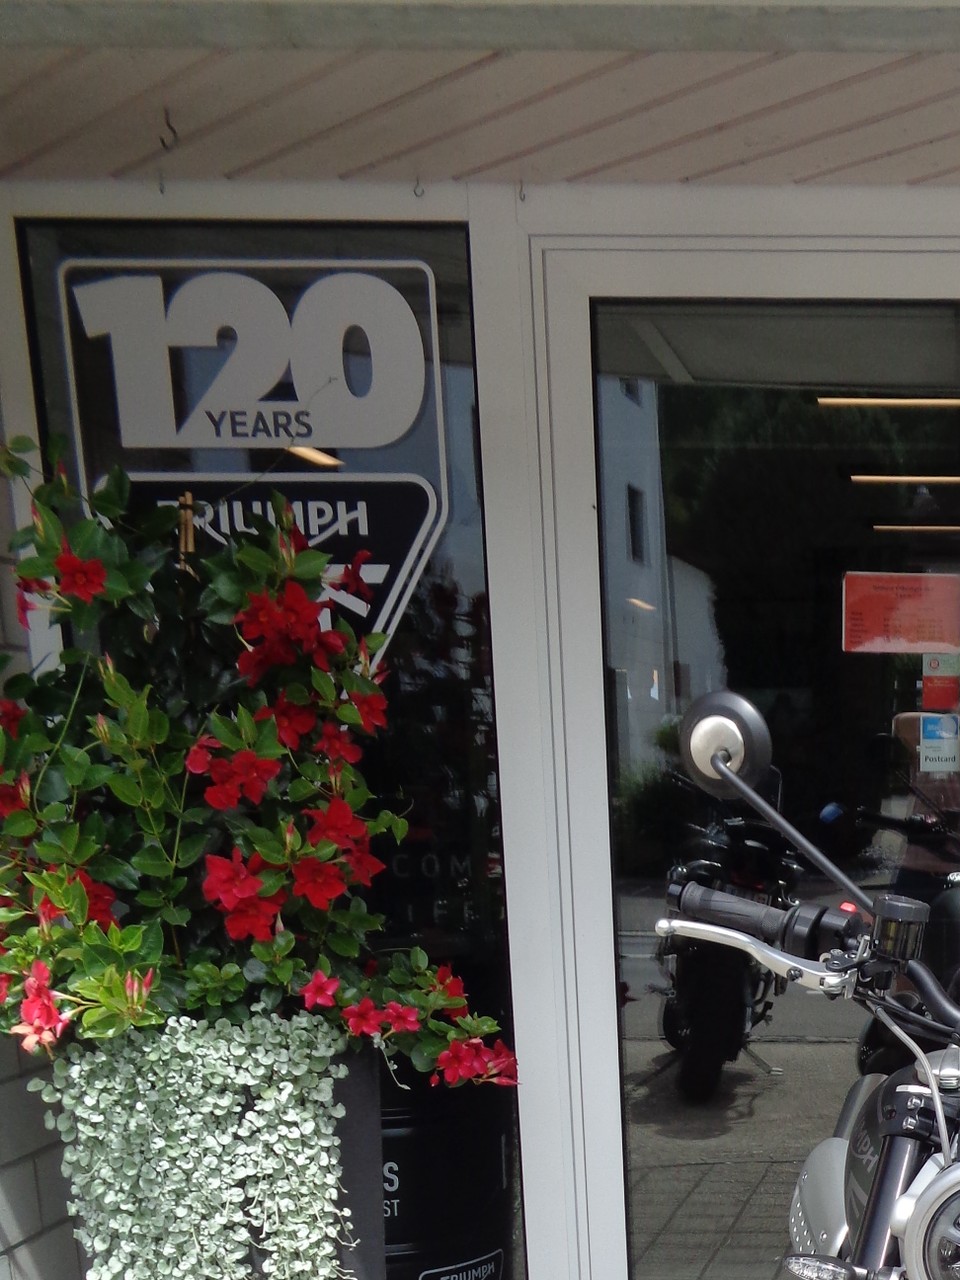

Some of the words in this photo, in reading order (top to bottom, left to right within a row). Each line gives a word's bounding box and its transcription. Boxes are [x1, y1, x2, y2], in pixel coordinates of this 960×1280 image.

[72, 272, 426, 448] 120
[205, 410, 313, 439] YEARS
[924, 754, 956, 764] Postcard
